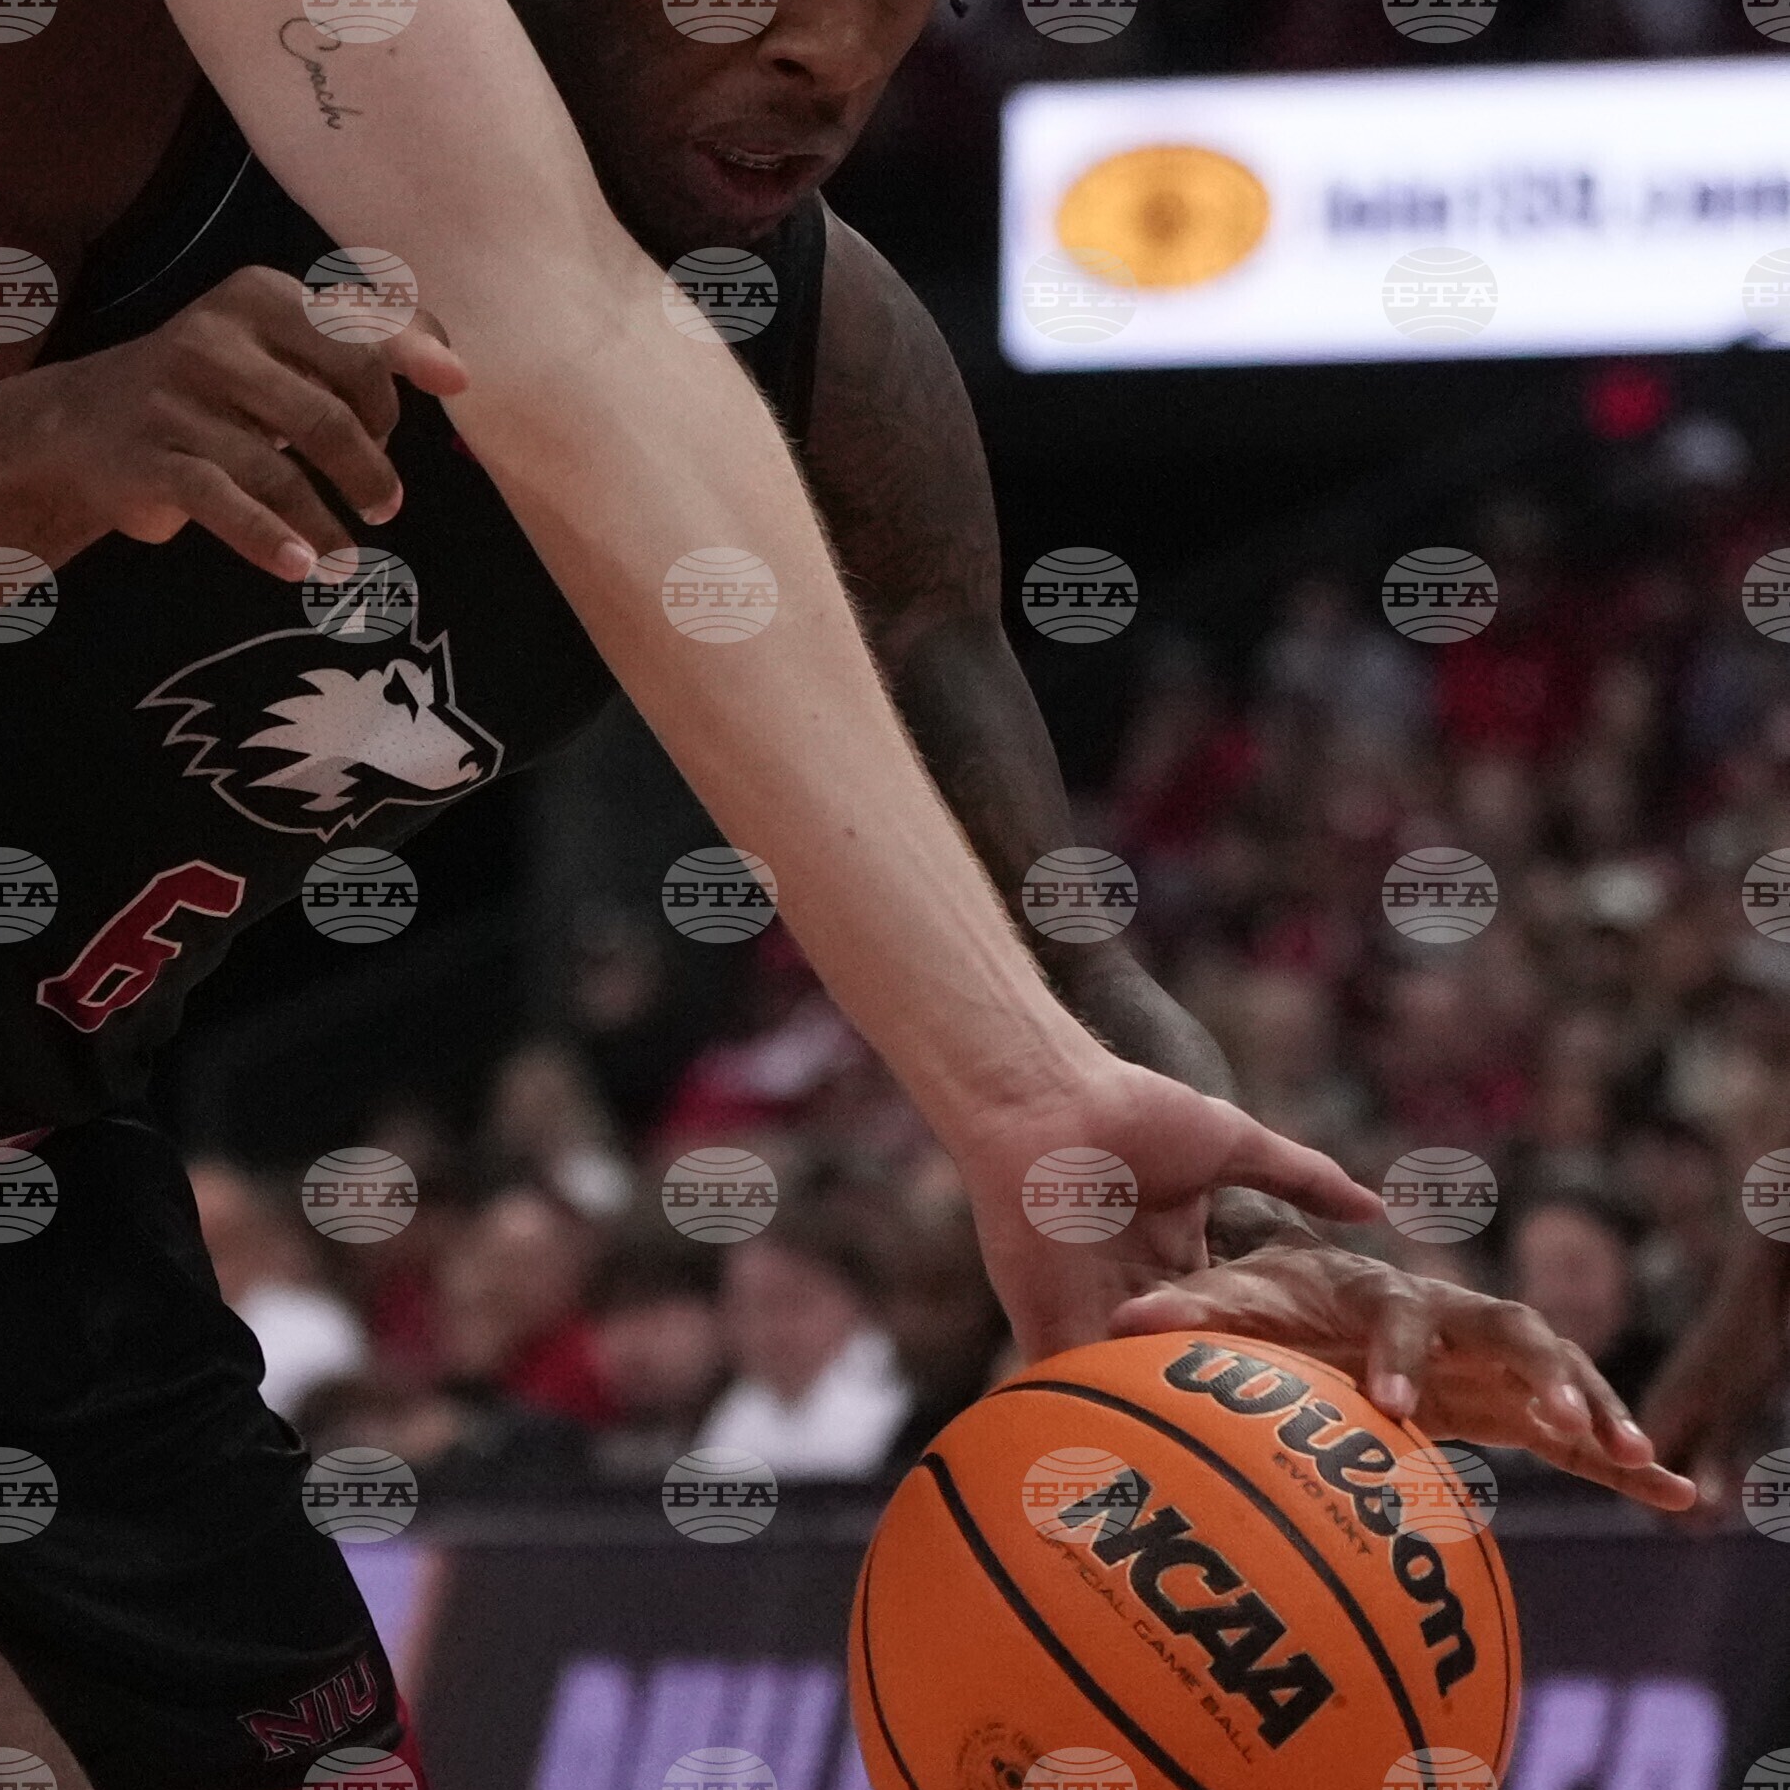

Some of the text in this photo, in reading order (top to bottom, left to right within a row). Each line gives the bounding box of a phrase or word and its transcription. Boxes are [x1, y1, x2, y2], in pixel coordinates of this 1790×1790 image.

[36, 859, 247, 1034] 6
[1163, 1341, 1477, 1699] Wilson
[1057, 1467, 1336, 1751] NCAA
[1132, 1618, 1201, 1694] GAME
[1199, 1694, 1252, 1763] BALL
[237, 1651, 378, 1761] NIU
